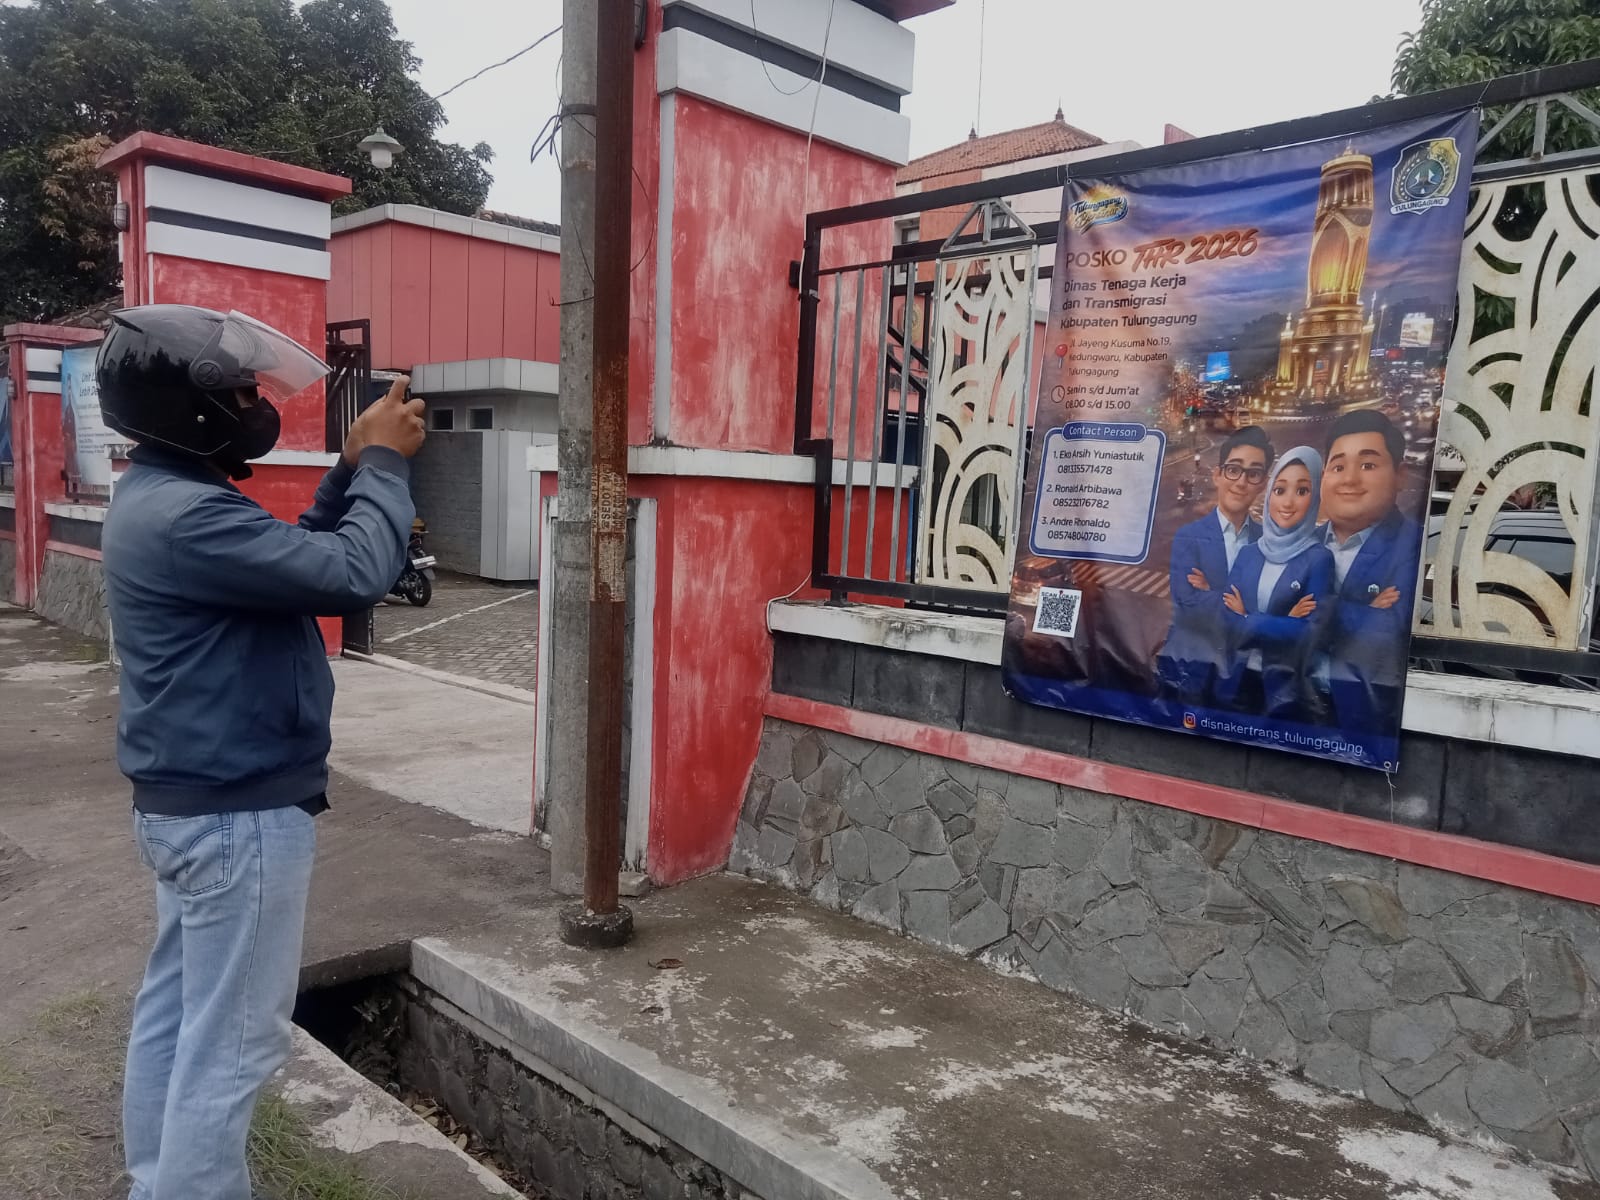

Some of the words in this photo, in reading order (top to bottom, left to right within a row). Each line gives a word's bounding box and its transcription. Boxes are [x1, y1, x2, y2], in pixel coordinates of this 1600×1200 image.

[1066, 249, 1127, 269] POSKO
[1132, 238, 1186, 272] THR
[1185, 228, 1259, 265] 2026
[1064, 279, 1097, 293] Dinas
[1101, 278, 1146, 292] Tenaga
[1150, 274, 1186, 291] Kerja
[1062, 298, 1080, 311] dan
[1085, 293, 1167, 310] Transmigrasi
[1122, 313, 1198, 327] Tulungagung
[1078, 339, 1109, 350] Jayeng
[1111, 338, 1145, 348] Kusuma
[1124, 352, 1168, 362] Kabupaten
[1066, 385, 1086, 395] Senin
[1089, 385, 1104, 395] s/d
[1106, 386, 1140, 396] Jum'at
[1087, 400, 1102, 409] s/d
[1105, 400, 1131, 409] 15.00
[1069, 426, 1100, 436] Contact
[1103, 426, 1137, 437] Person
[1072, 449, 1091, 459] Arsih
[1093, 449, 1145, 461] Yuniastutik
[1079, 484, 1122, 496] Arbibawa
[601, 485, 611, 519] SEDOT
[1050, 517, 1073, 526] Andre
[1200, 717, 1363, 756] disnakertrans_tulungagung
